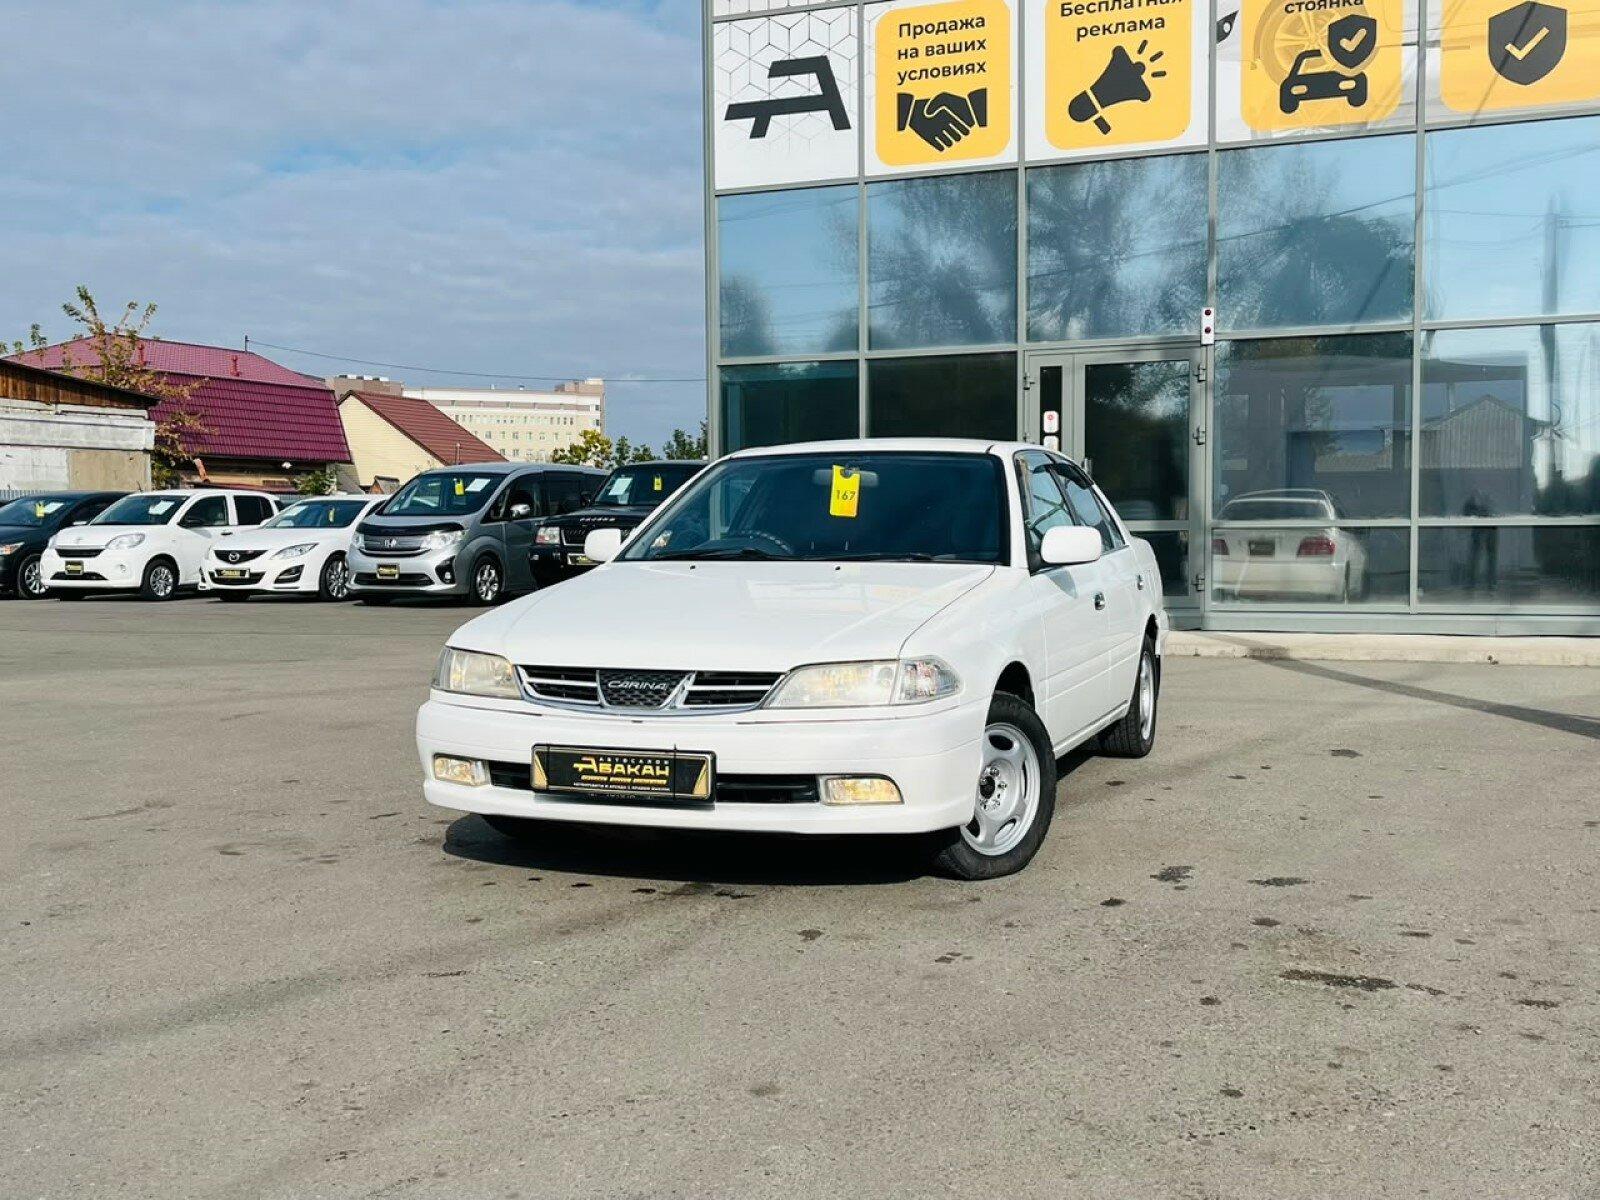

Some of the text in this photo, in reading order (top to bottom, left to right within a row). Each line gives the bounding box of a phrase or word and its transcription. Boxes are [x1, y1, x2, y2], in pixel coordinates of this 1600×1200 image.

[899, 16, 985, 39] Продажа
[1076, 17, 1165, 42] реклама
[897, 39, 986, 60] на ваших
[897, 61, 986, 86] условиях
[836, 490, 856, 501] 167
[608, 680, 668, 690] CARINA
